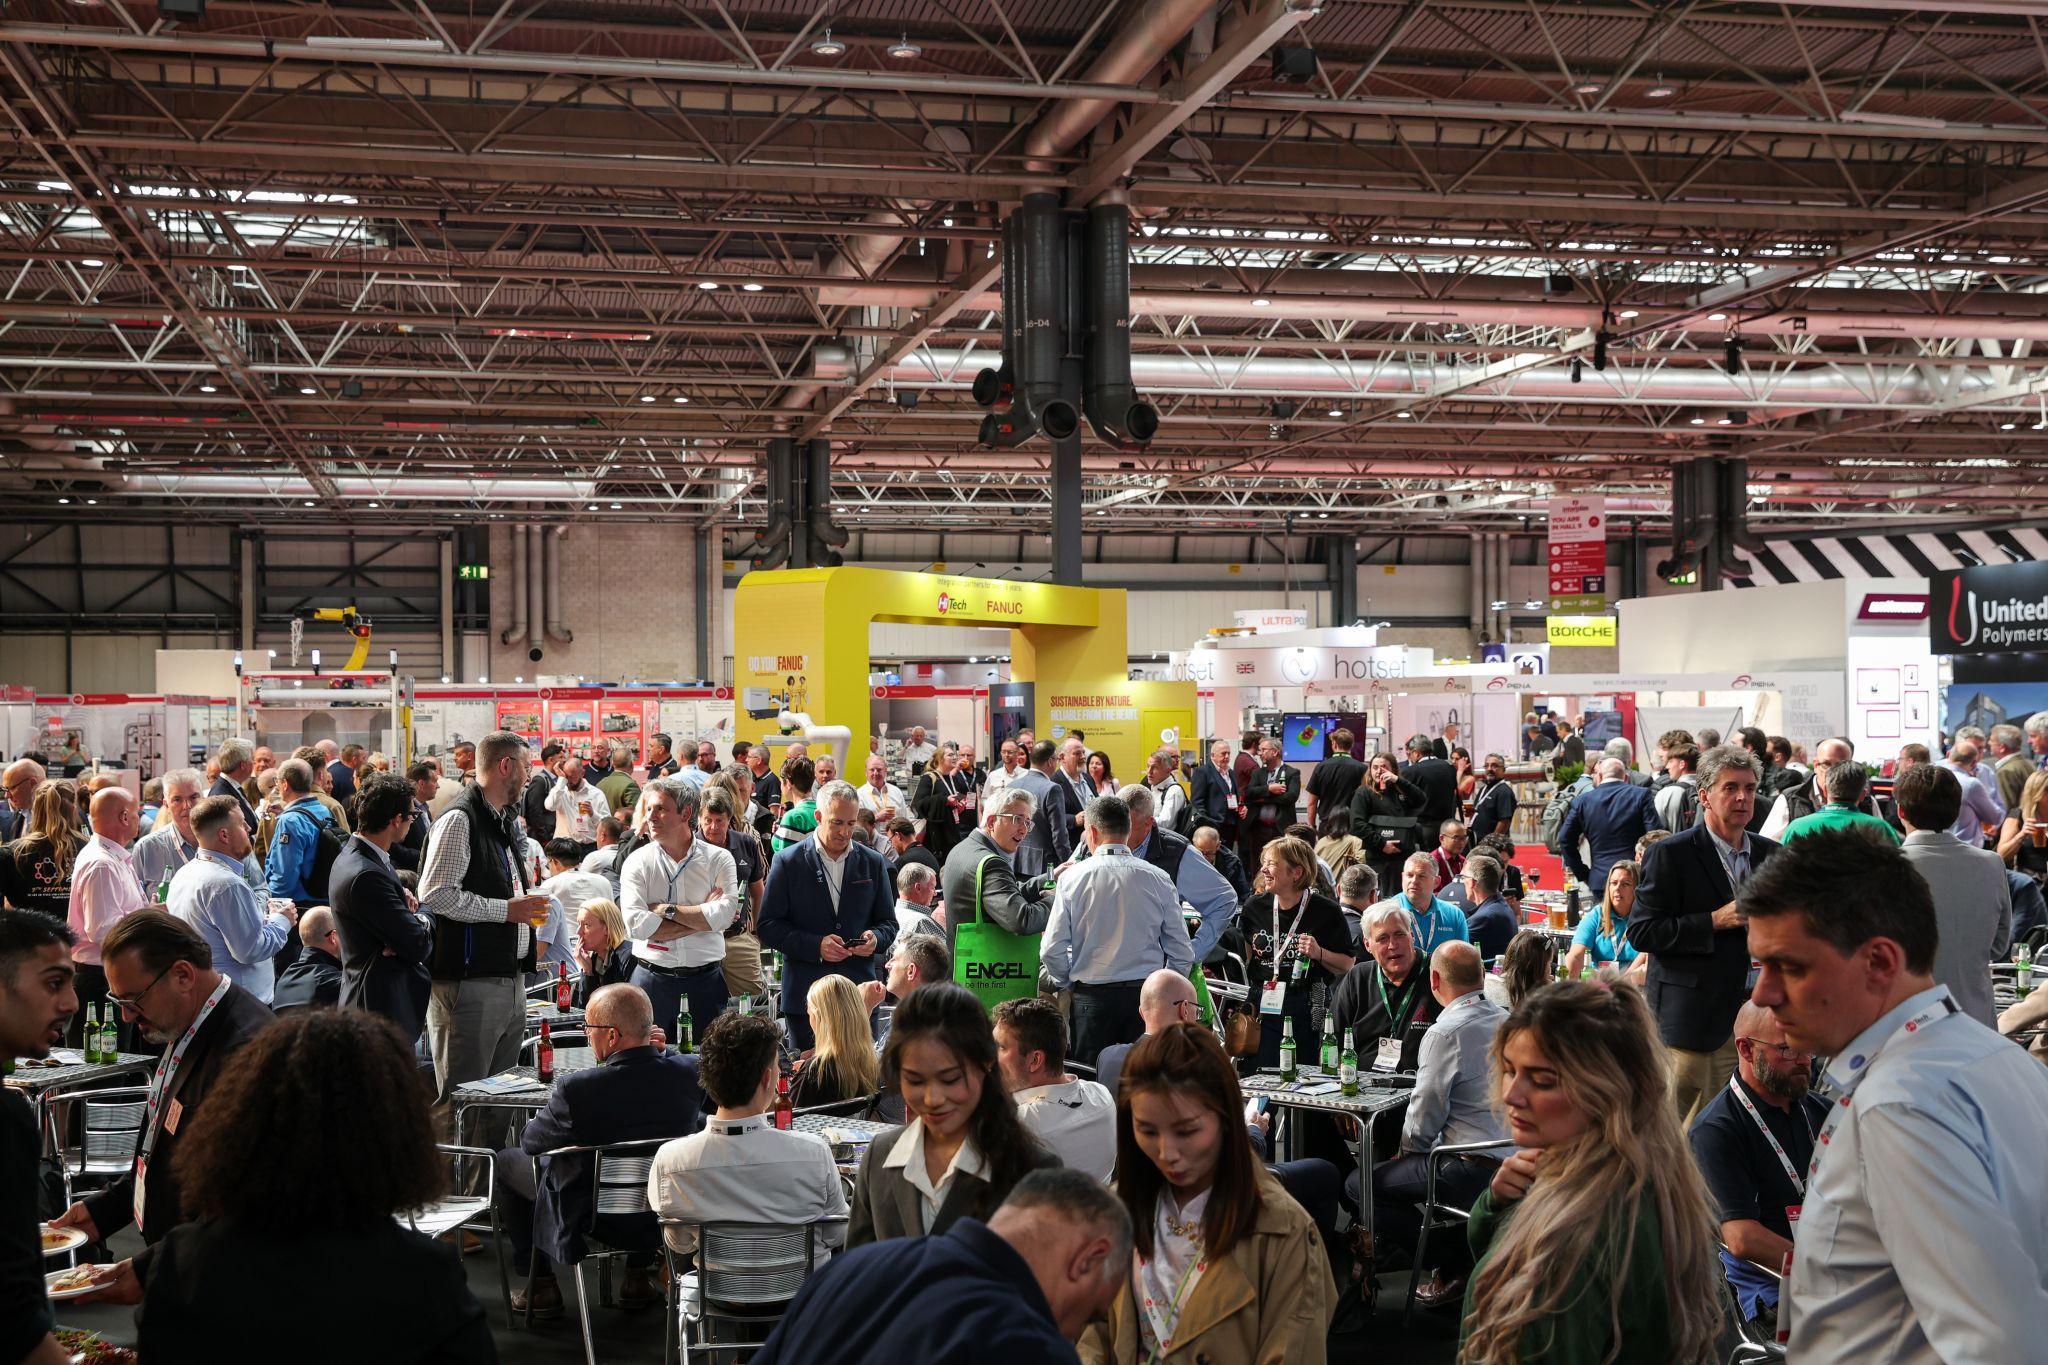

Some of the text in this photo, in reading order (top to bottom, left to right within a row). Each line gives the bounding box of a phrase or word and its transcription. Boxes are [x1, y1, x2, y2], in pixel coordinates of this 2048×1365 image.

[987, 601, 1023, 615] FANUC
[1983, 595, 2048, 624] United
[1551, 627, 1613, 637] BORCHE
[1983, 626, 2048, 647] Polymers
[1173, 661, 1214, 681] otset
[1334, 654, 1407, 679] hotset
[1050, 696, 1094, 707] SUSTAINABLE
[1096, 696, 1105, 707] BY
[966, 962, 1031, 979] ENGEL
[977, 981, 989, 989] the
[991, 981, 1006, 989] first
